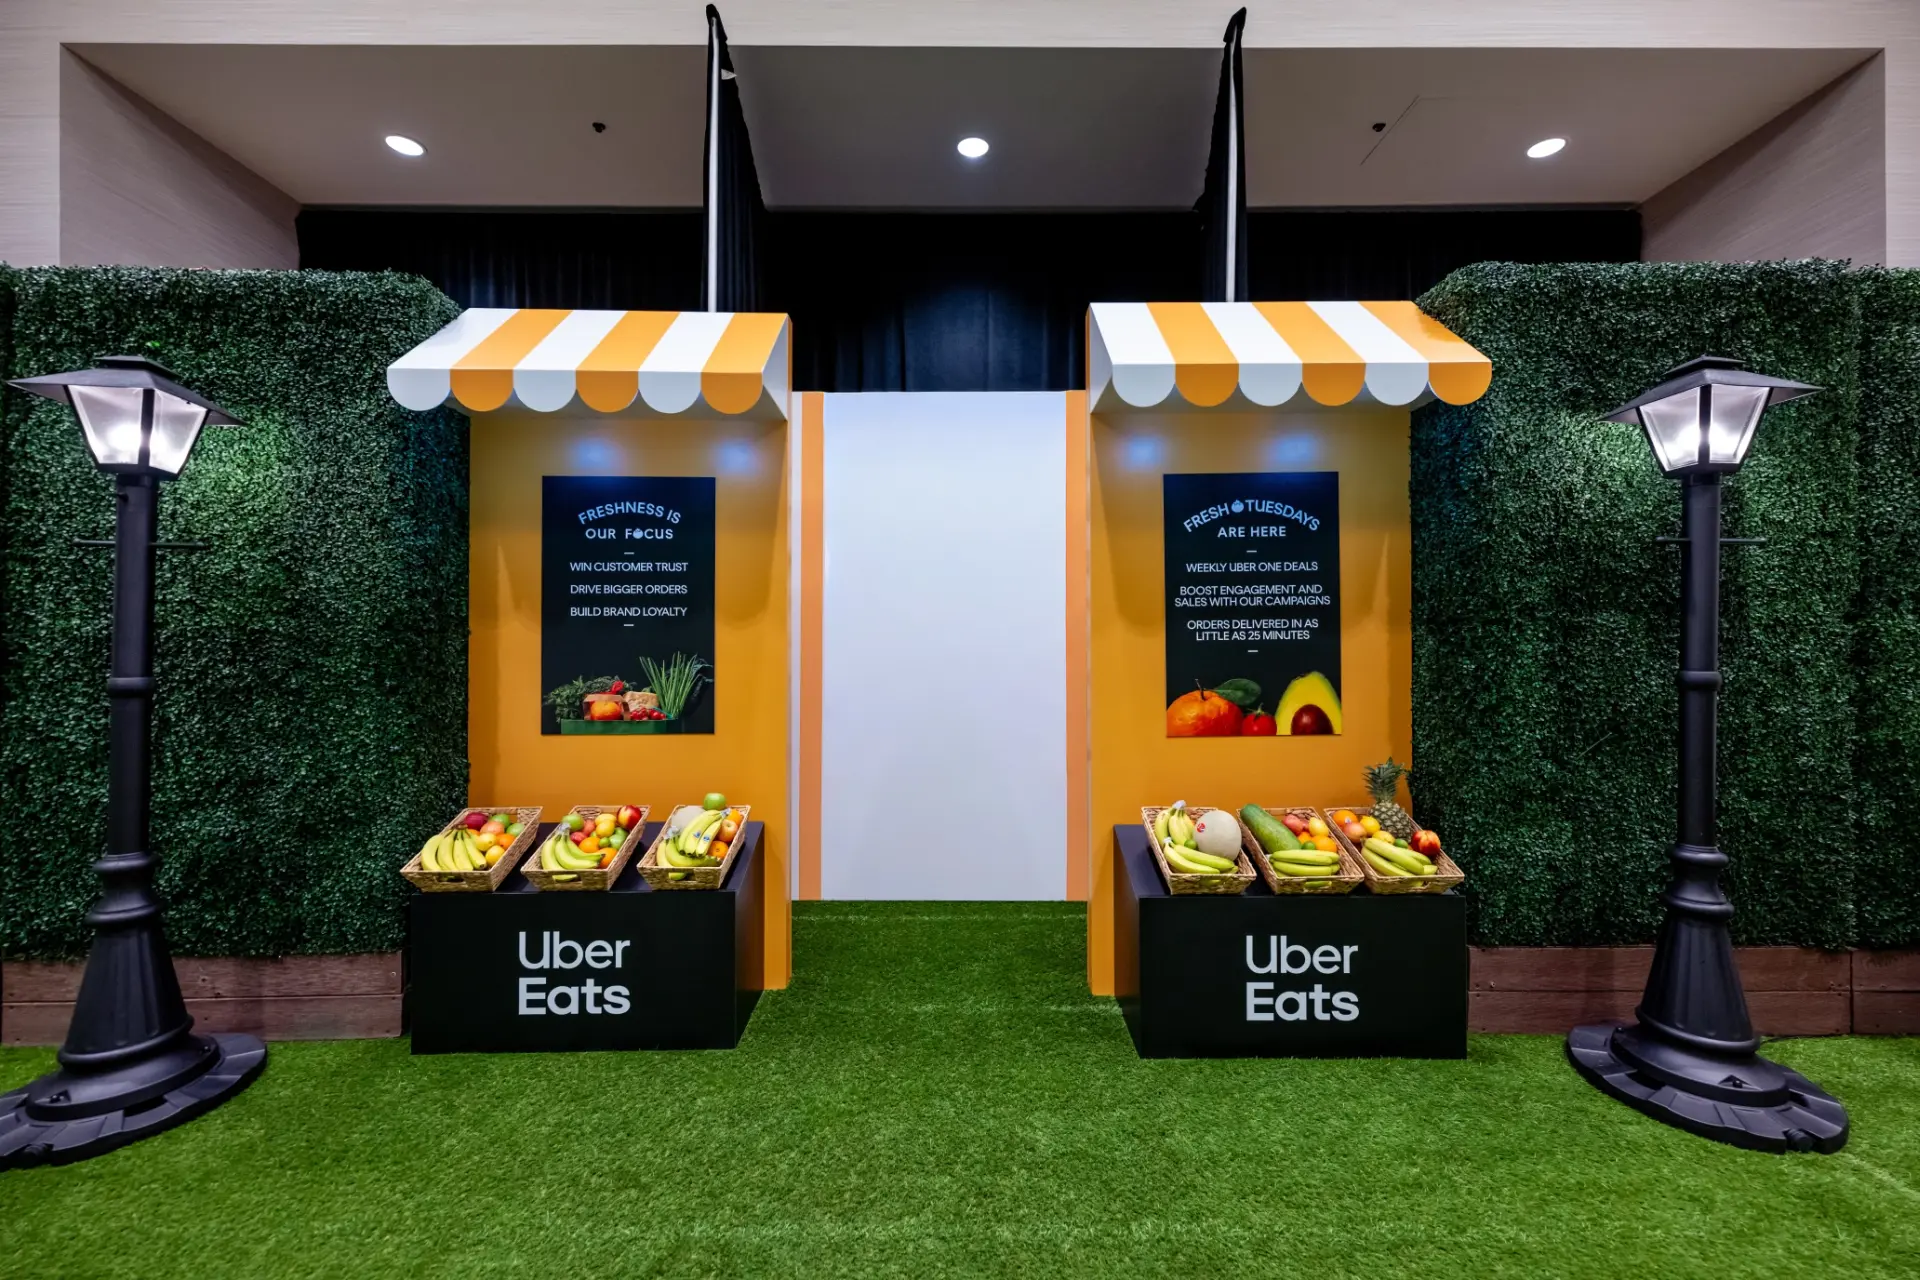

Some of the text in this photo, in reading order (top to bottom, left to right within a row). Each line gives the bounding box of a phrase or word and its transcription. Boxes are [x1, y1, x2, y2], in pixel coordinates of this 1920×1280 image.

[578, 501, 681, 525] FRESHNESS IS
[1183, 499, 1320, 532] FRESH TUESDAYS
[585, 528, 616, 539] OUR
[1217, 526, 1286, 538] ARE HERE
[570, 562, 688, 572] WIN CUSTOMER TRUST
[1186, 562, 1318, 573] WEEKLY UBER ONE DEALS
[570, 585, 688, 594] DRIVE BIGGER ORDERS
[1180, 585, 1323, 596] BOOST ENGAGEMENT AND
[1174, 596, 1330, 607] SALES WITH OUR CAMPAIGNS
[570, 607, 687, 616] BUILD BRAND LOYALTY
[1187, 619, 1318, 630] ORDERS DELIVERED IN AS
[1196, 630, 1310, 641] LITTLE AS 25 MINUTES
[519, 931, 630, 969] Uber
[1246, 935, 1358, 974] Uber
[518, 977, 631, 1015] Eats
[1246, 982, 1359, 1021] Eats
